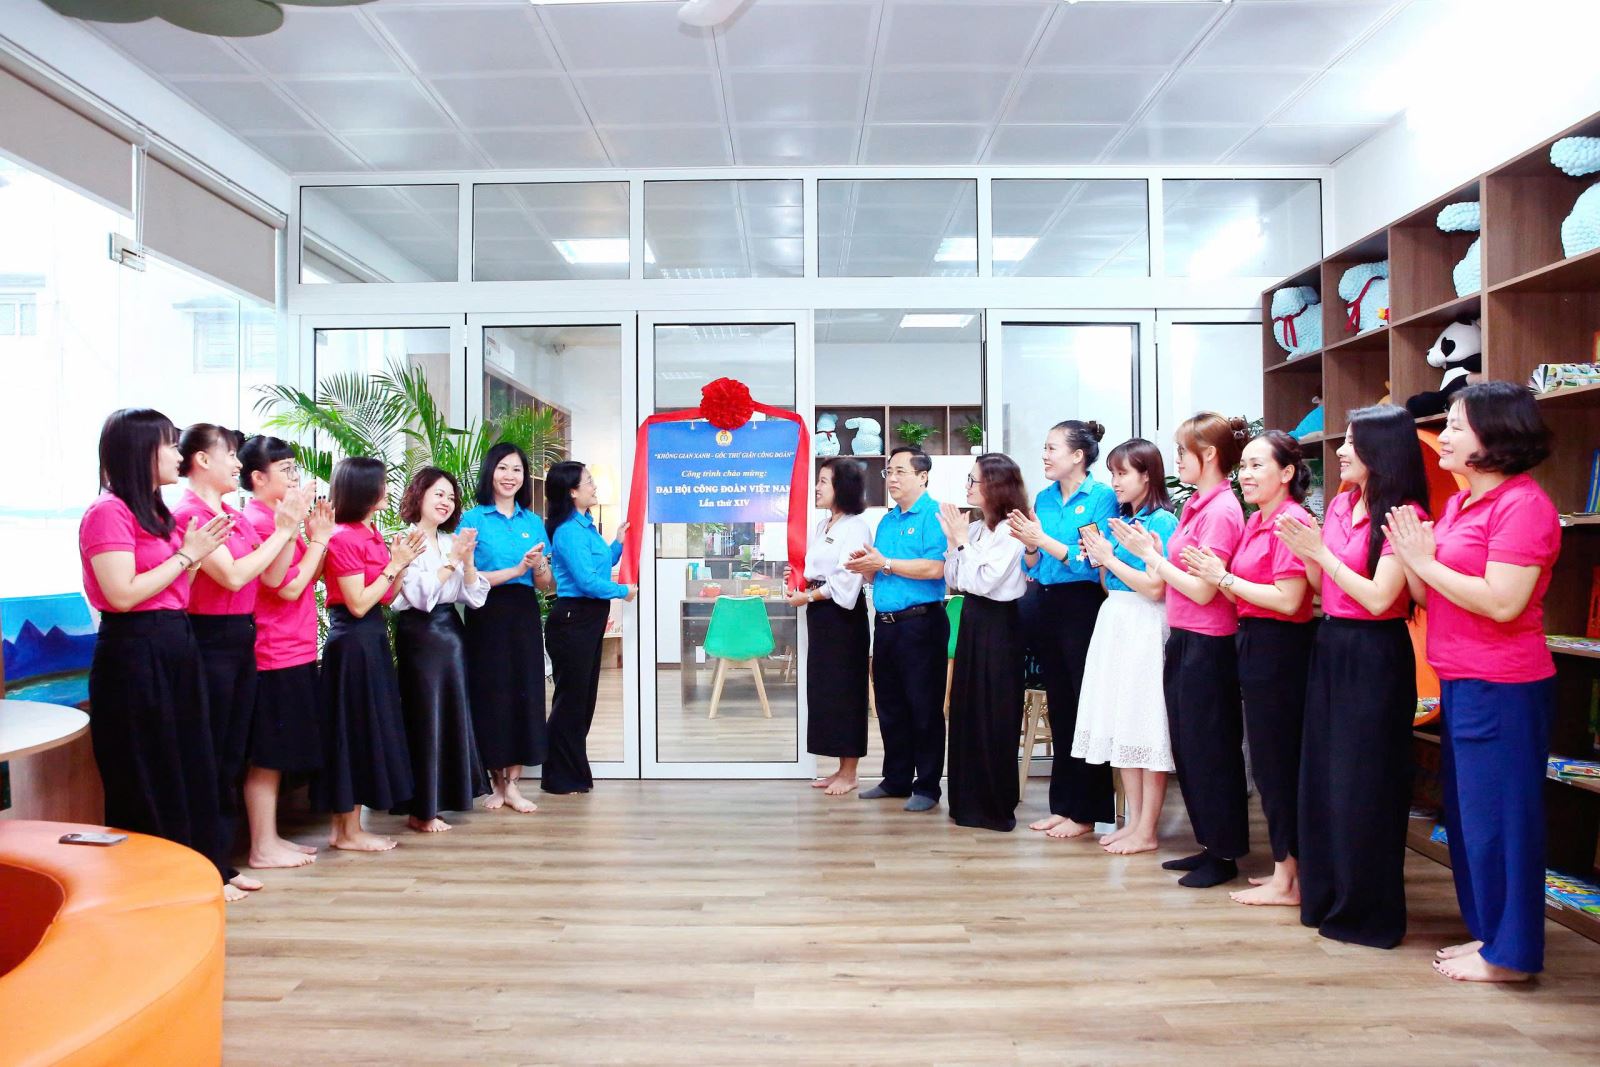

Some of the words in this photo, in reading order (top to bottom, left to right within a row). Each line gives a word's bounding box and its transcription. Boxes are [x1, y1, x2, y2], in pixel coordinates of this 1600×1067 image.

[681, 470, 701, 479] Công
[655, 485, 673, 495] ĐẠI
[674, 484, 691, 495] HỘI
[693, 484, 718, 493] CÔNG
[720, 483, 747, 493] ĐOÀN
[749, 484, 771, 494] VIỆT
[733, 498, 750, 507] XIV
